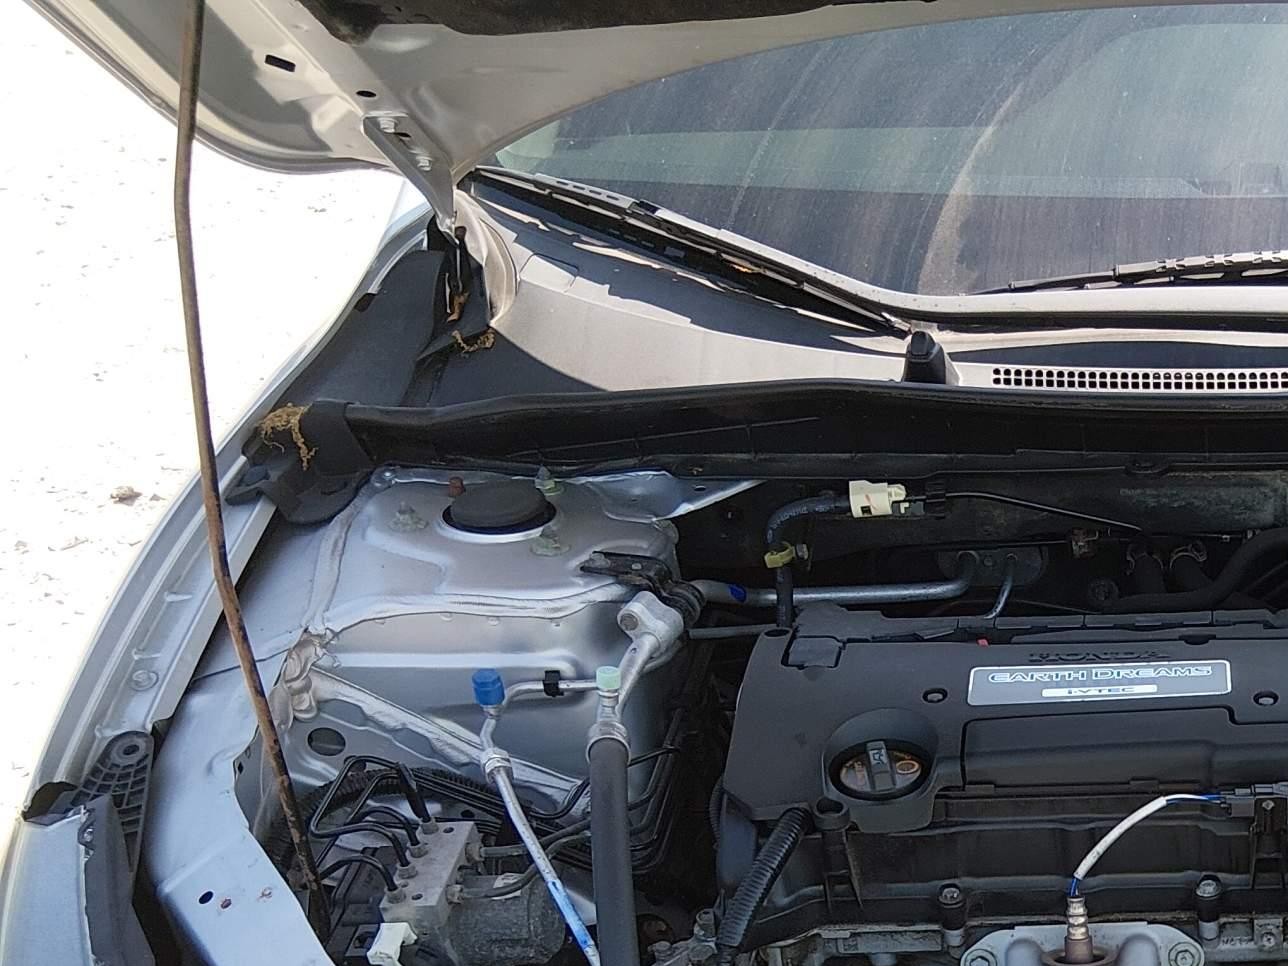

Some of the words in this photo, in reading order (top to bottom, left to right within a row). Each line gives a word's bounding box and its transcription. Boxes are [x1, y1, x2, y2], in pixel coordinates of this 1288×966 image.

[1029, 650, 1171, 663] HONDA
[988, 670, 1087, 683] EARTH
[1092, 665, 1213, 681] DREAMS
